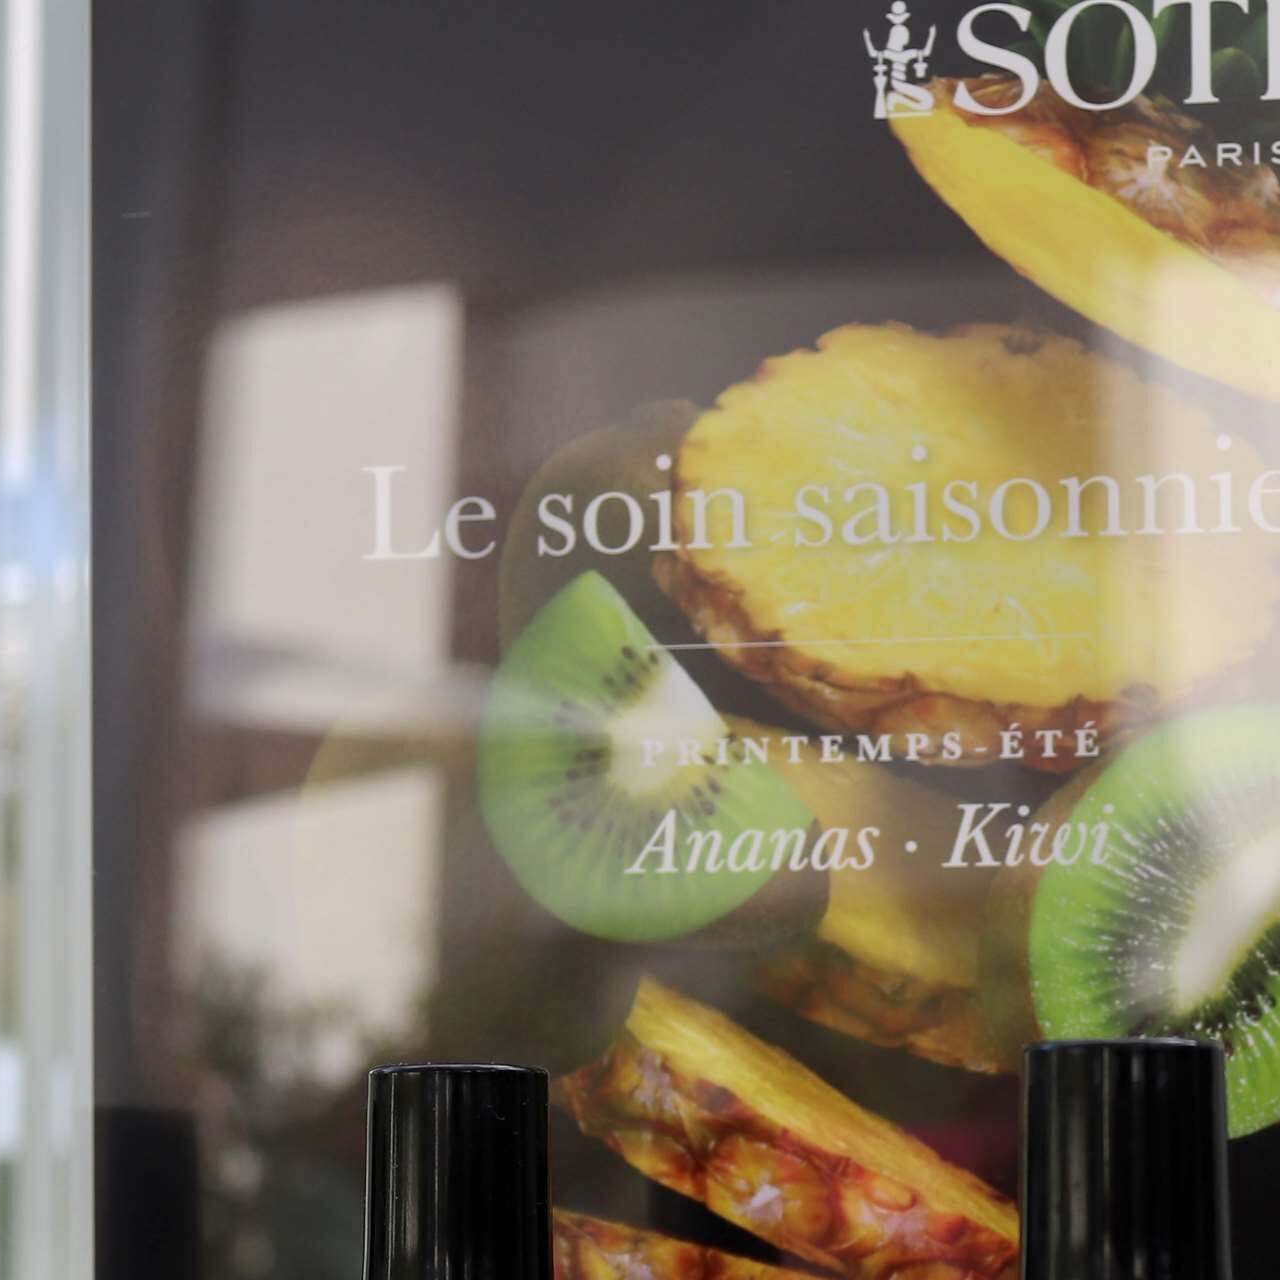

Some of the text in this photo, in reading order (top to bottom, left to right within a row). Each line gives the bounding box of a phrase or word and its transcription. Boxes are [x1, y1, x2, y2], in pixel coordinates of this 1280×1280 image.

[361, 464, 498, 561] Le
[535, 453, 751, 557] soin
[643, 719, 1101, 767] PRINTEMPS-ÉTÉ
[623, 807, 881, 876] Ananas
[941, 798, 1120, 870] Kiwi
